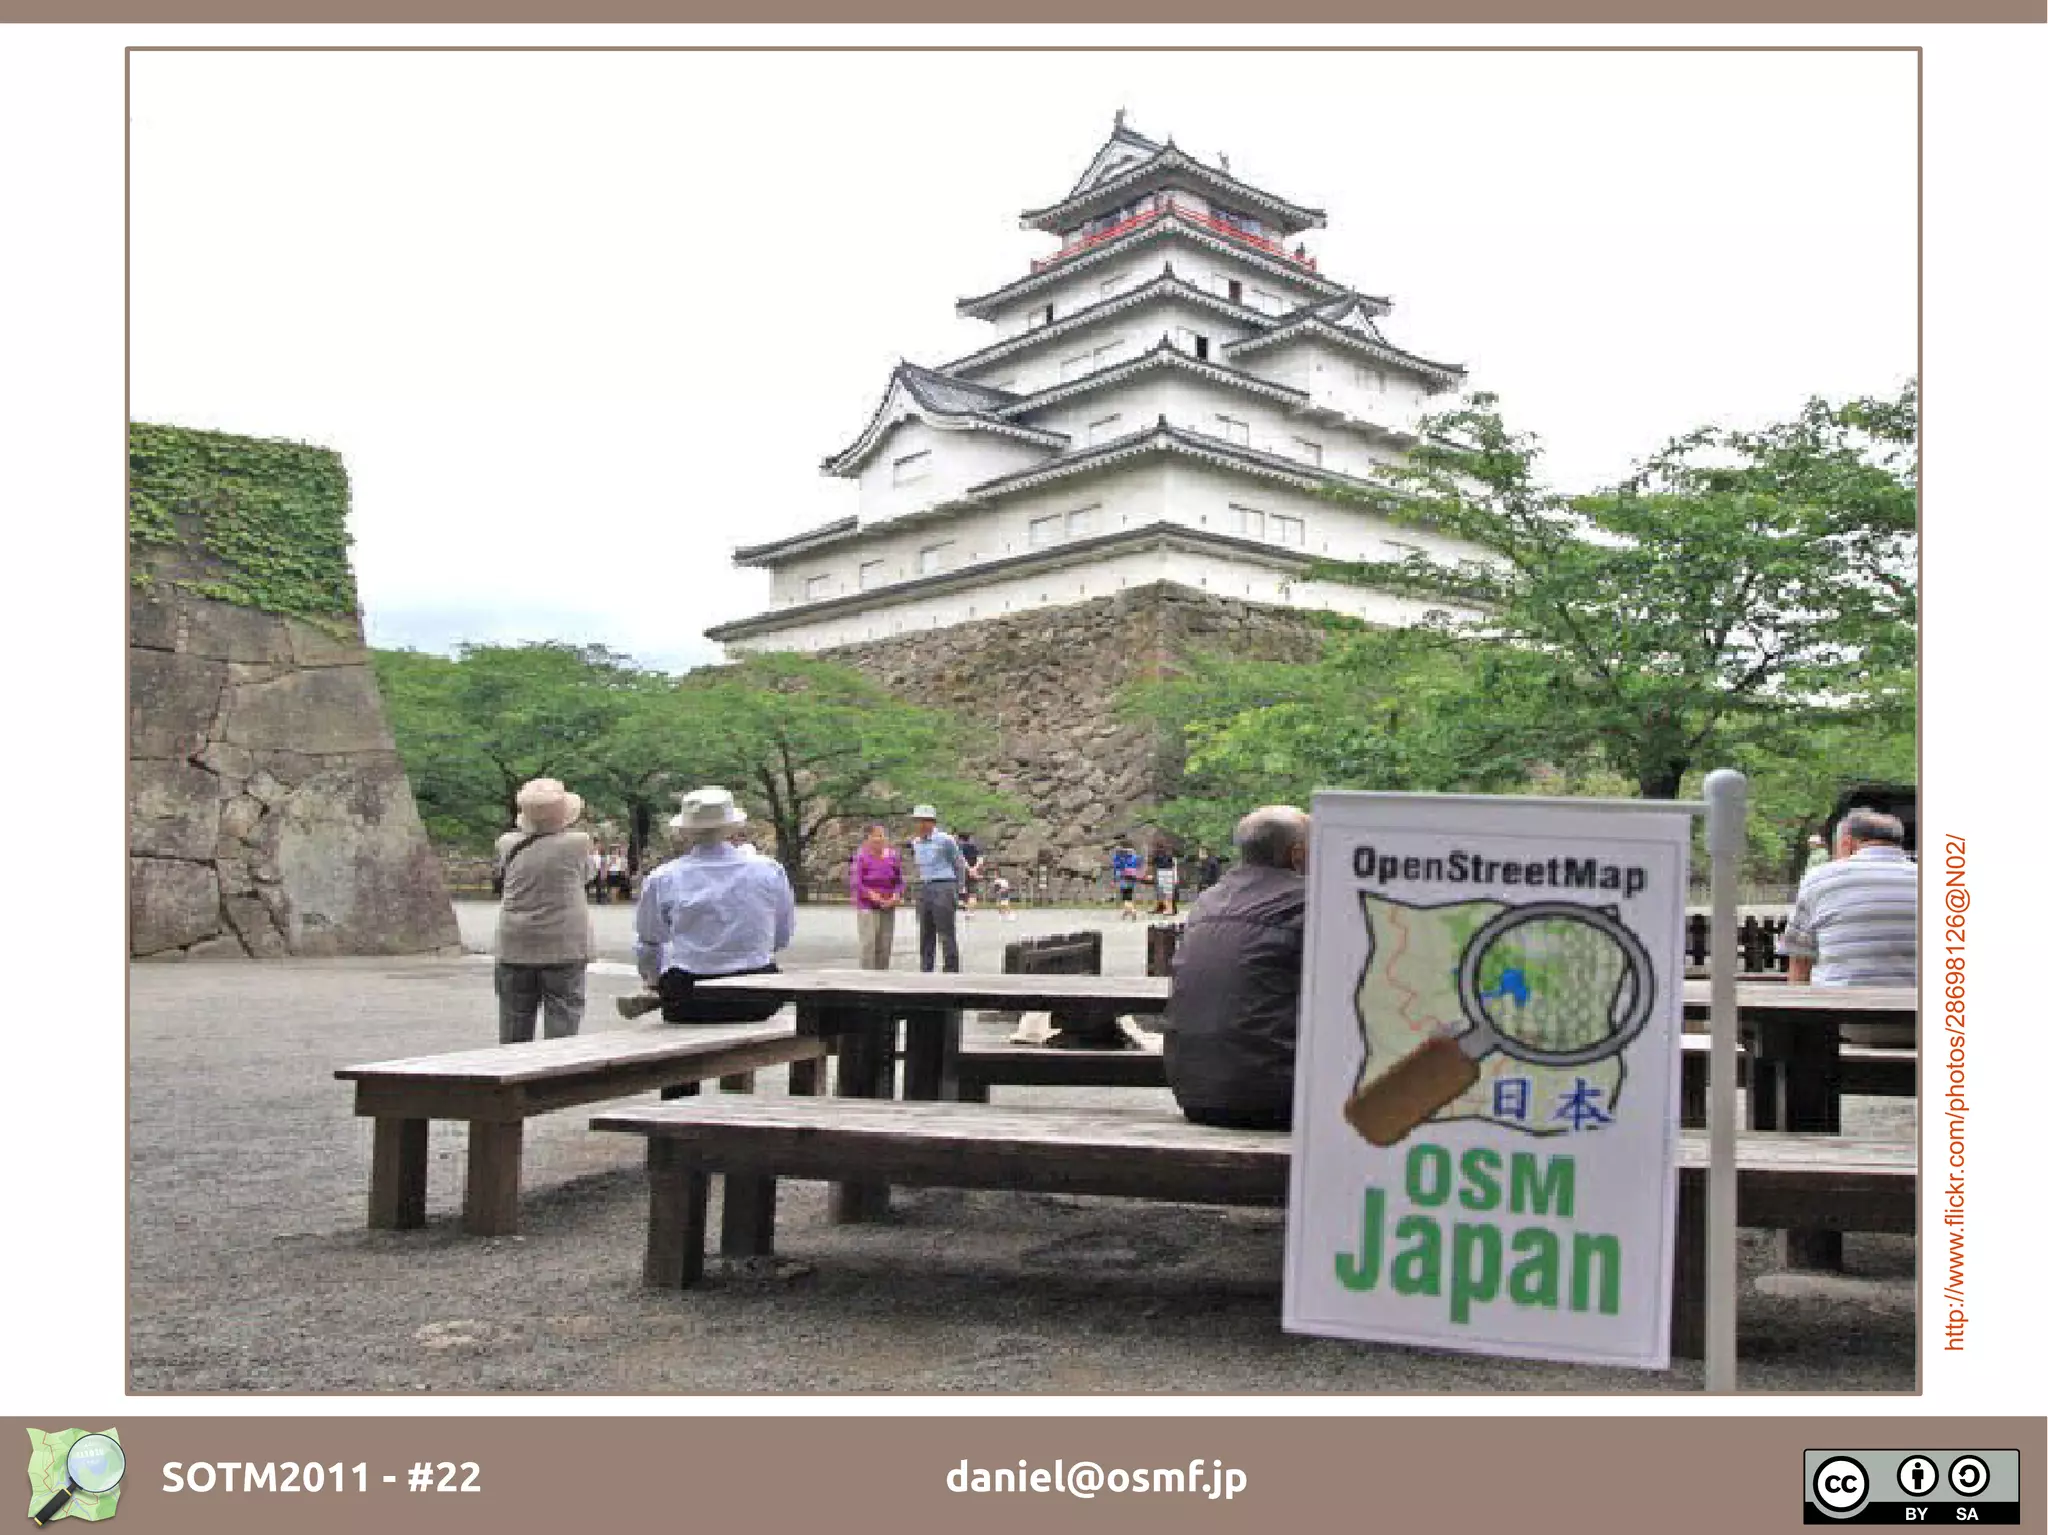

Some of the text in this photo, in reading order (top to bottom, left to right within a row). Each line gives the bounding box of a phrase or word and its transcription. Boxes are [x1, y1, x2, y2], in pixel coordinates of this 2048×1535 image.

[1353, 845, 1648, 897] OpenStreetMap
[1494, 1077, 1613, 1130] 日本
[1405, 1142, 1575, 1217] OSM
[1335, 1187, 1620, 1323] Japan
